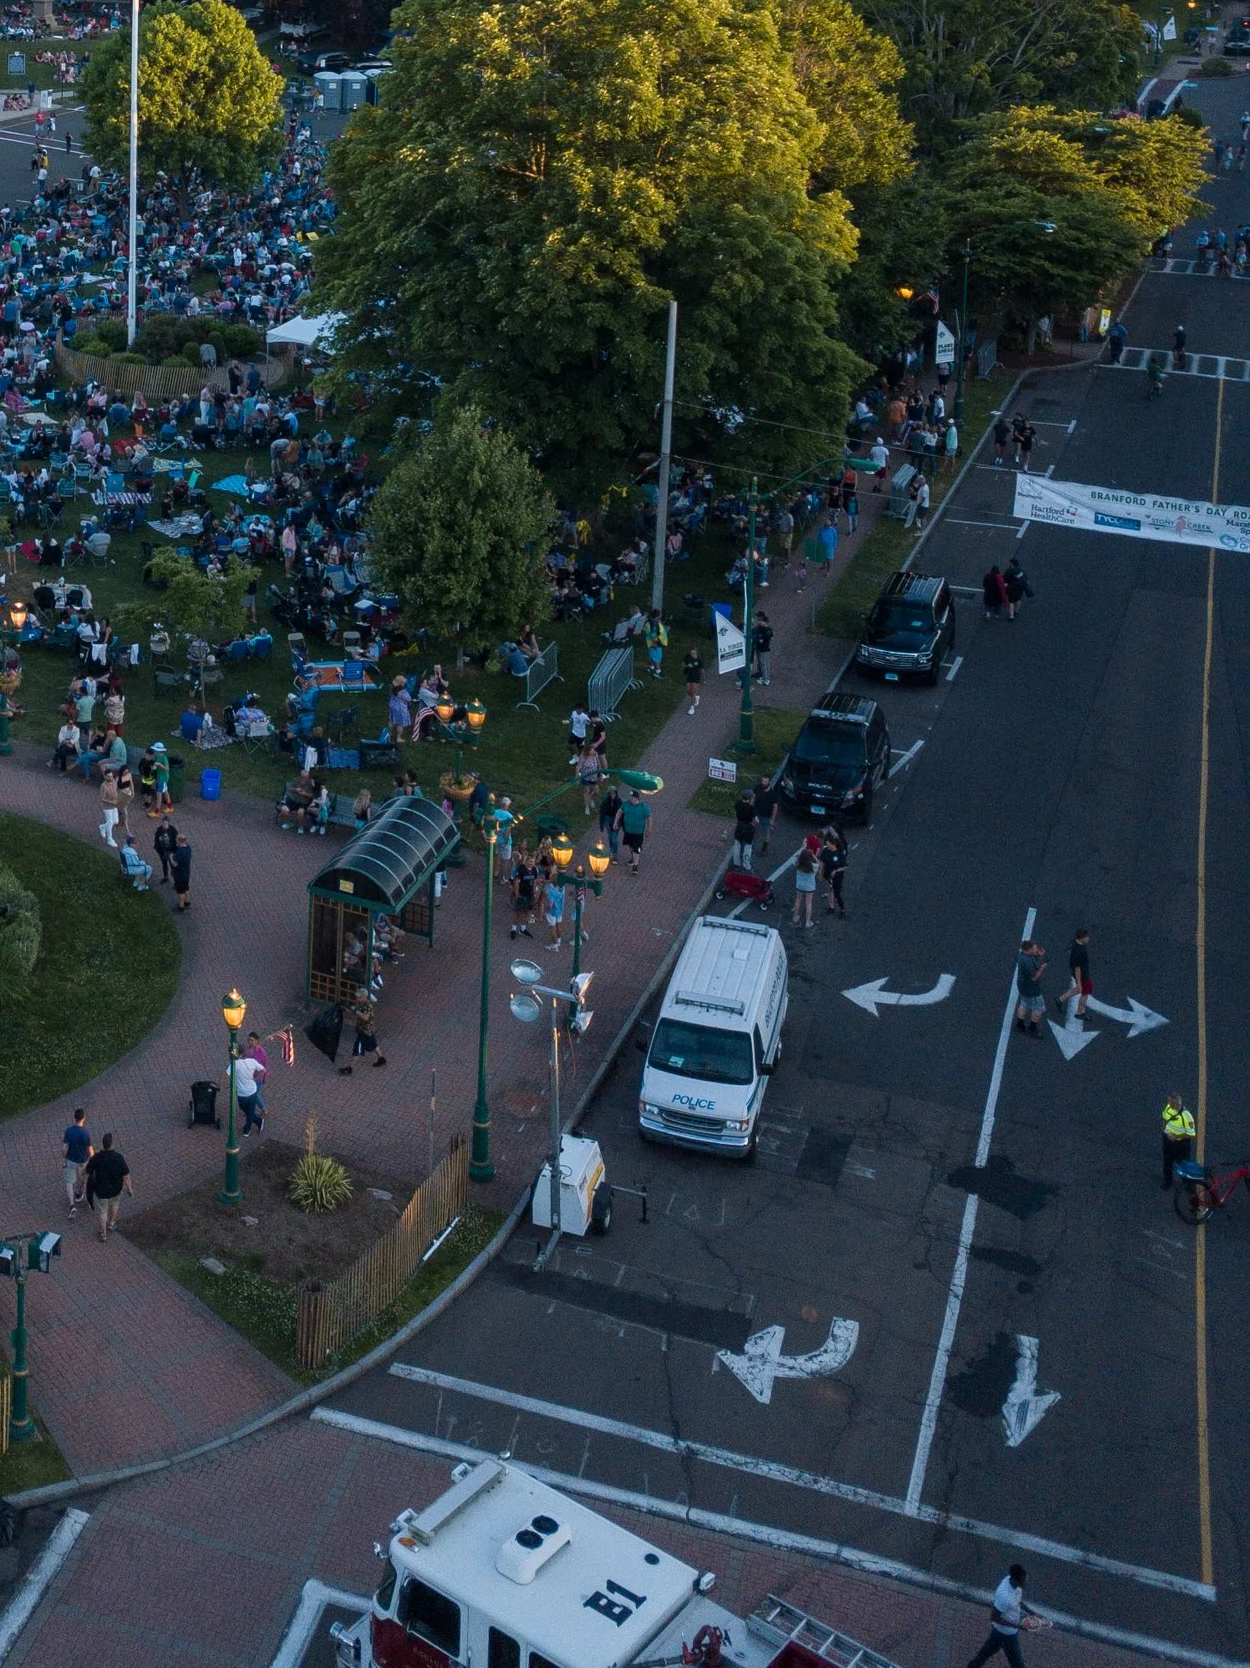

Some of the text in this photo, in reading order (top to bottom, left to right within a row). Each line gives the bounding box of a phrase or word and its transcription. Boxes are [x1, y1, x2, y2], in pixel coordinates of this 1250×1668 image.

[1031, 504, 1064, 515] Hartford
[1090, 491, 1146, 506] BRANFORD
[1152, 500, 1200, 513] FATHER'S
[1206, 507, 1227, 517] DAY
[1030, 511, 1075, 524] HealthCare
[671, 1093, 716, 1110] POLICE
